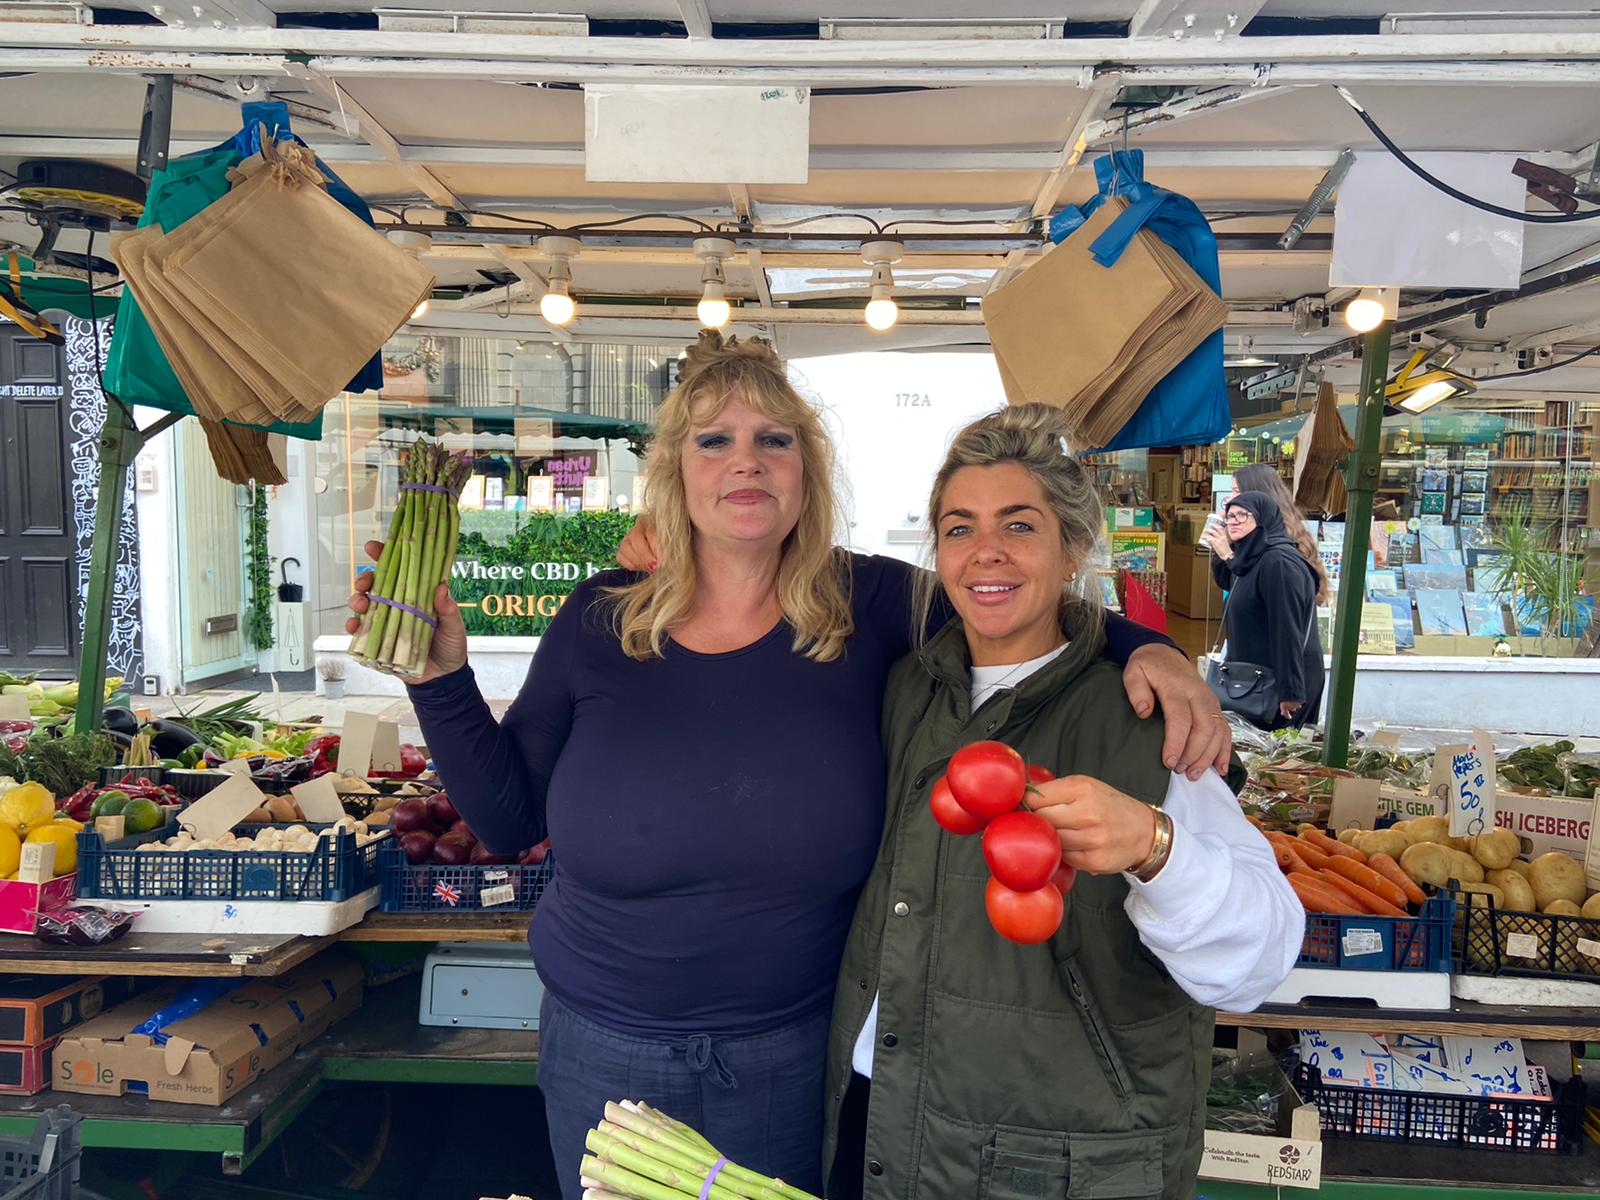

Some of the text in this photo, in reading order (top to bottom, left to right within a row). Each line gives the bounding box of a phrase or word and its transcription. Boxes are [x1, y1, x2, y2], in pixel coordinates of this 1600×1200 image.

[12, 385, 36, 397] DELETE
[37, 386, 57, 397] LATER
[895, 393, 932, 407] 172A
[451, 561, 524, 580] Where
[530, 562, 580, 581] CBD
[1406, 801, 1435, 816] GEM
[1519, 813, 1590, 841] ICEBERG
[157, 1080, 214, 1095] Fresh Herbs
